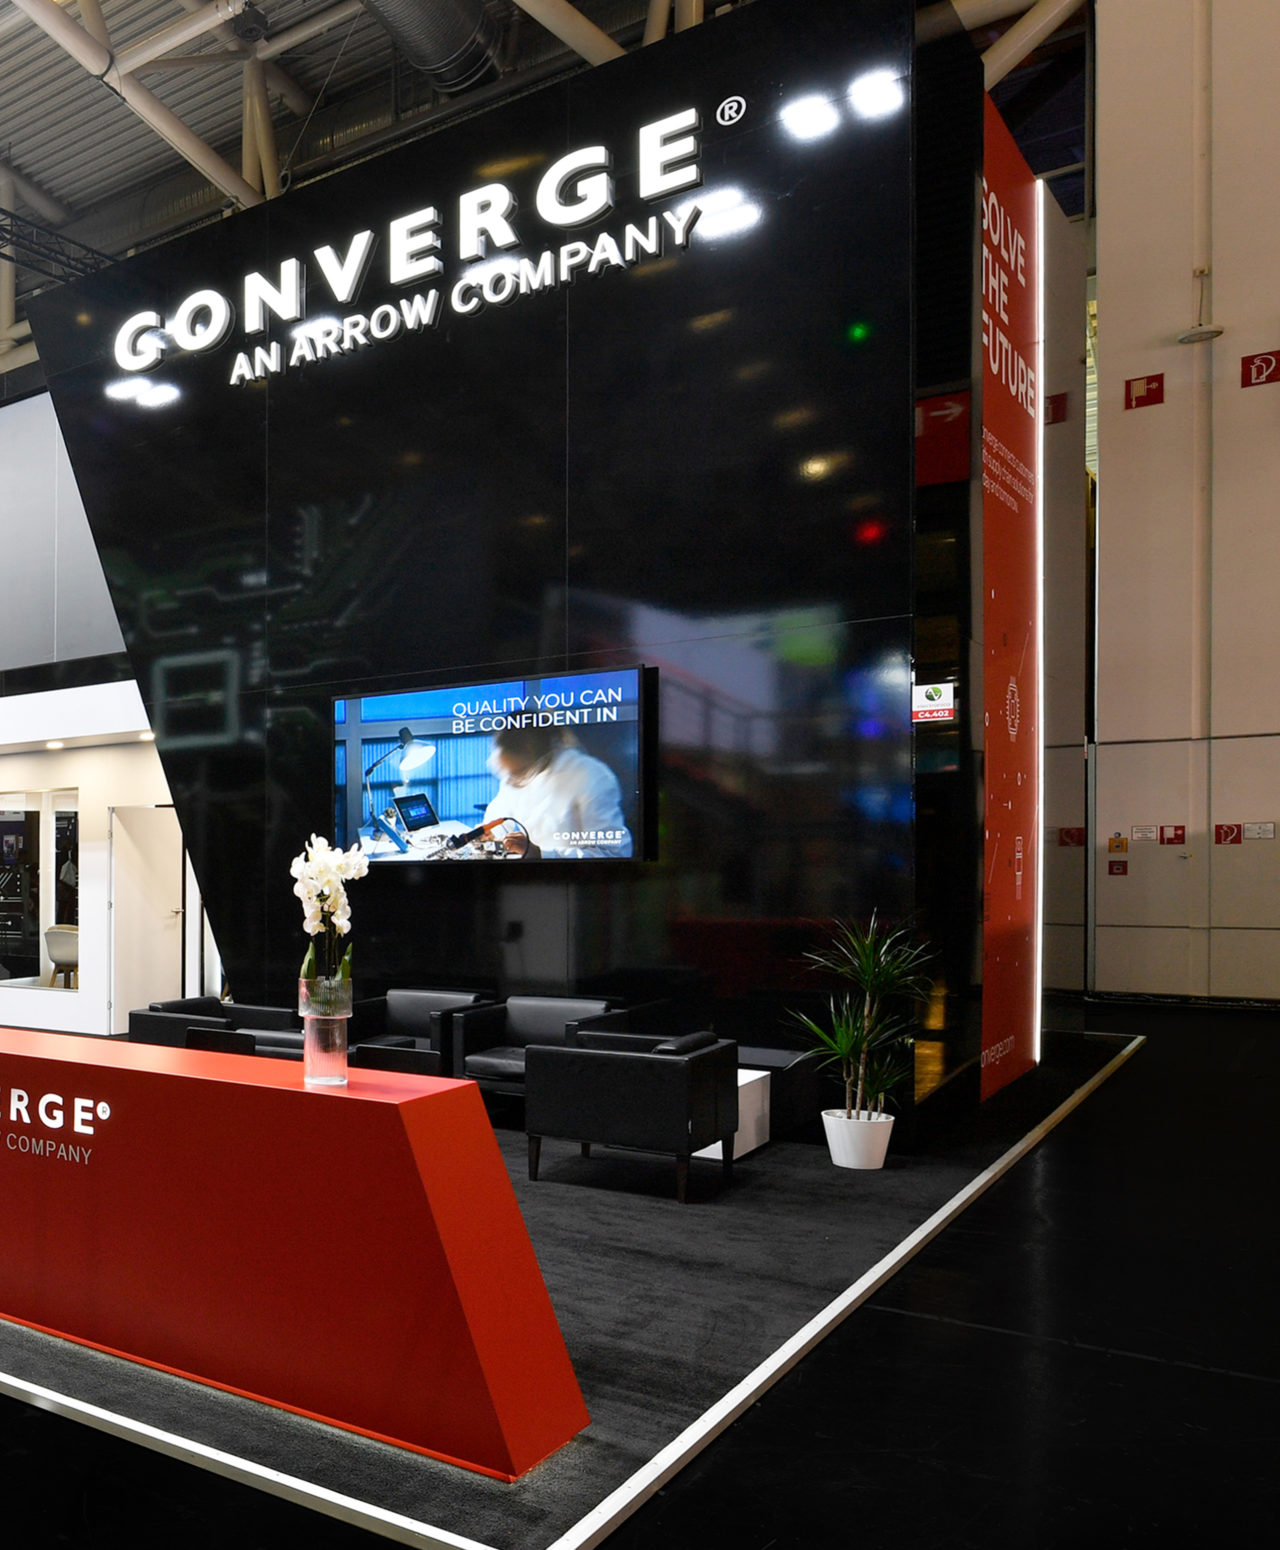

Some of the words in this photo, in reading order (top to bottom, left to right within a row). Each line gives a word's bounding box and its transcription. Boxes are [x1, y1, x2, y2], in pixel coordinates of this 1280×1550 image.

[230, 341, 282, 386] AN
[289, 289, 440, 367] ARROW
[451, 204, 703, 314] COMPANY
[452, 696, 530, 717] QUALITY
[534, 691, 574, 709] YOU
[580, 687, 622, 705] CAN
[918, 710, 949, 719] C4.402
[452, 720, 475, 735] BE
[479, 708, 592, 732] CONFIDENT
[596, 706, 617, 721] IN
[6, 1133, 92, 1165] COMPANY
